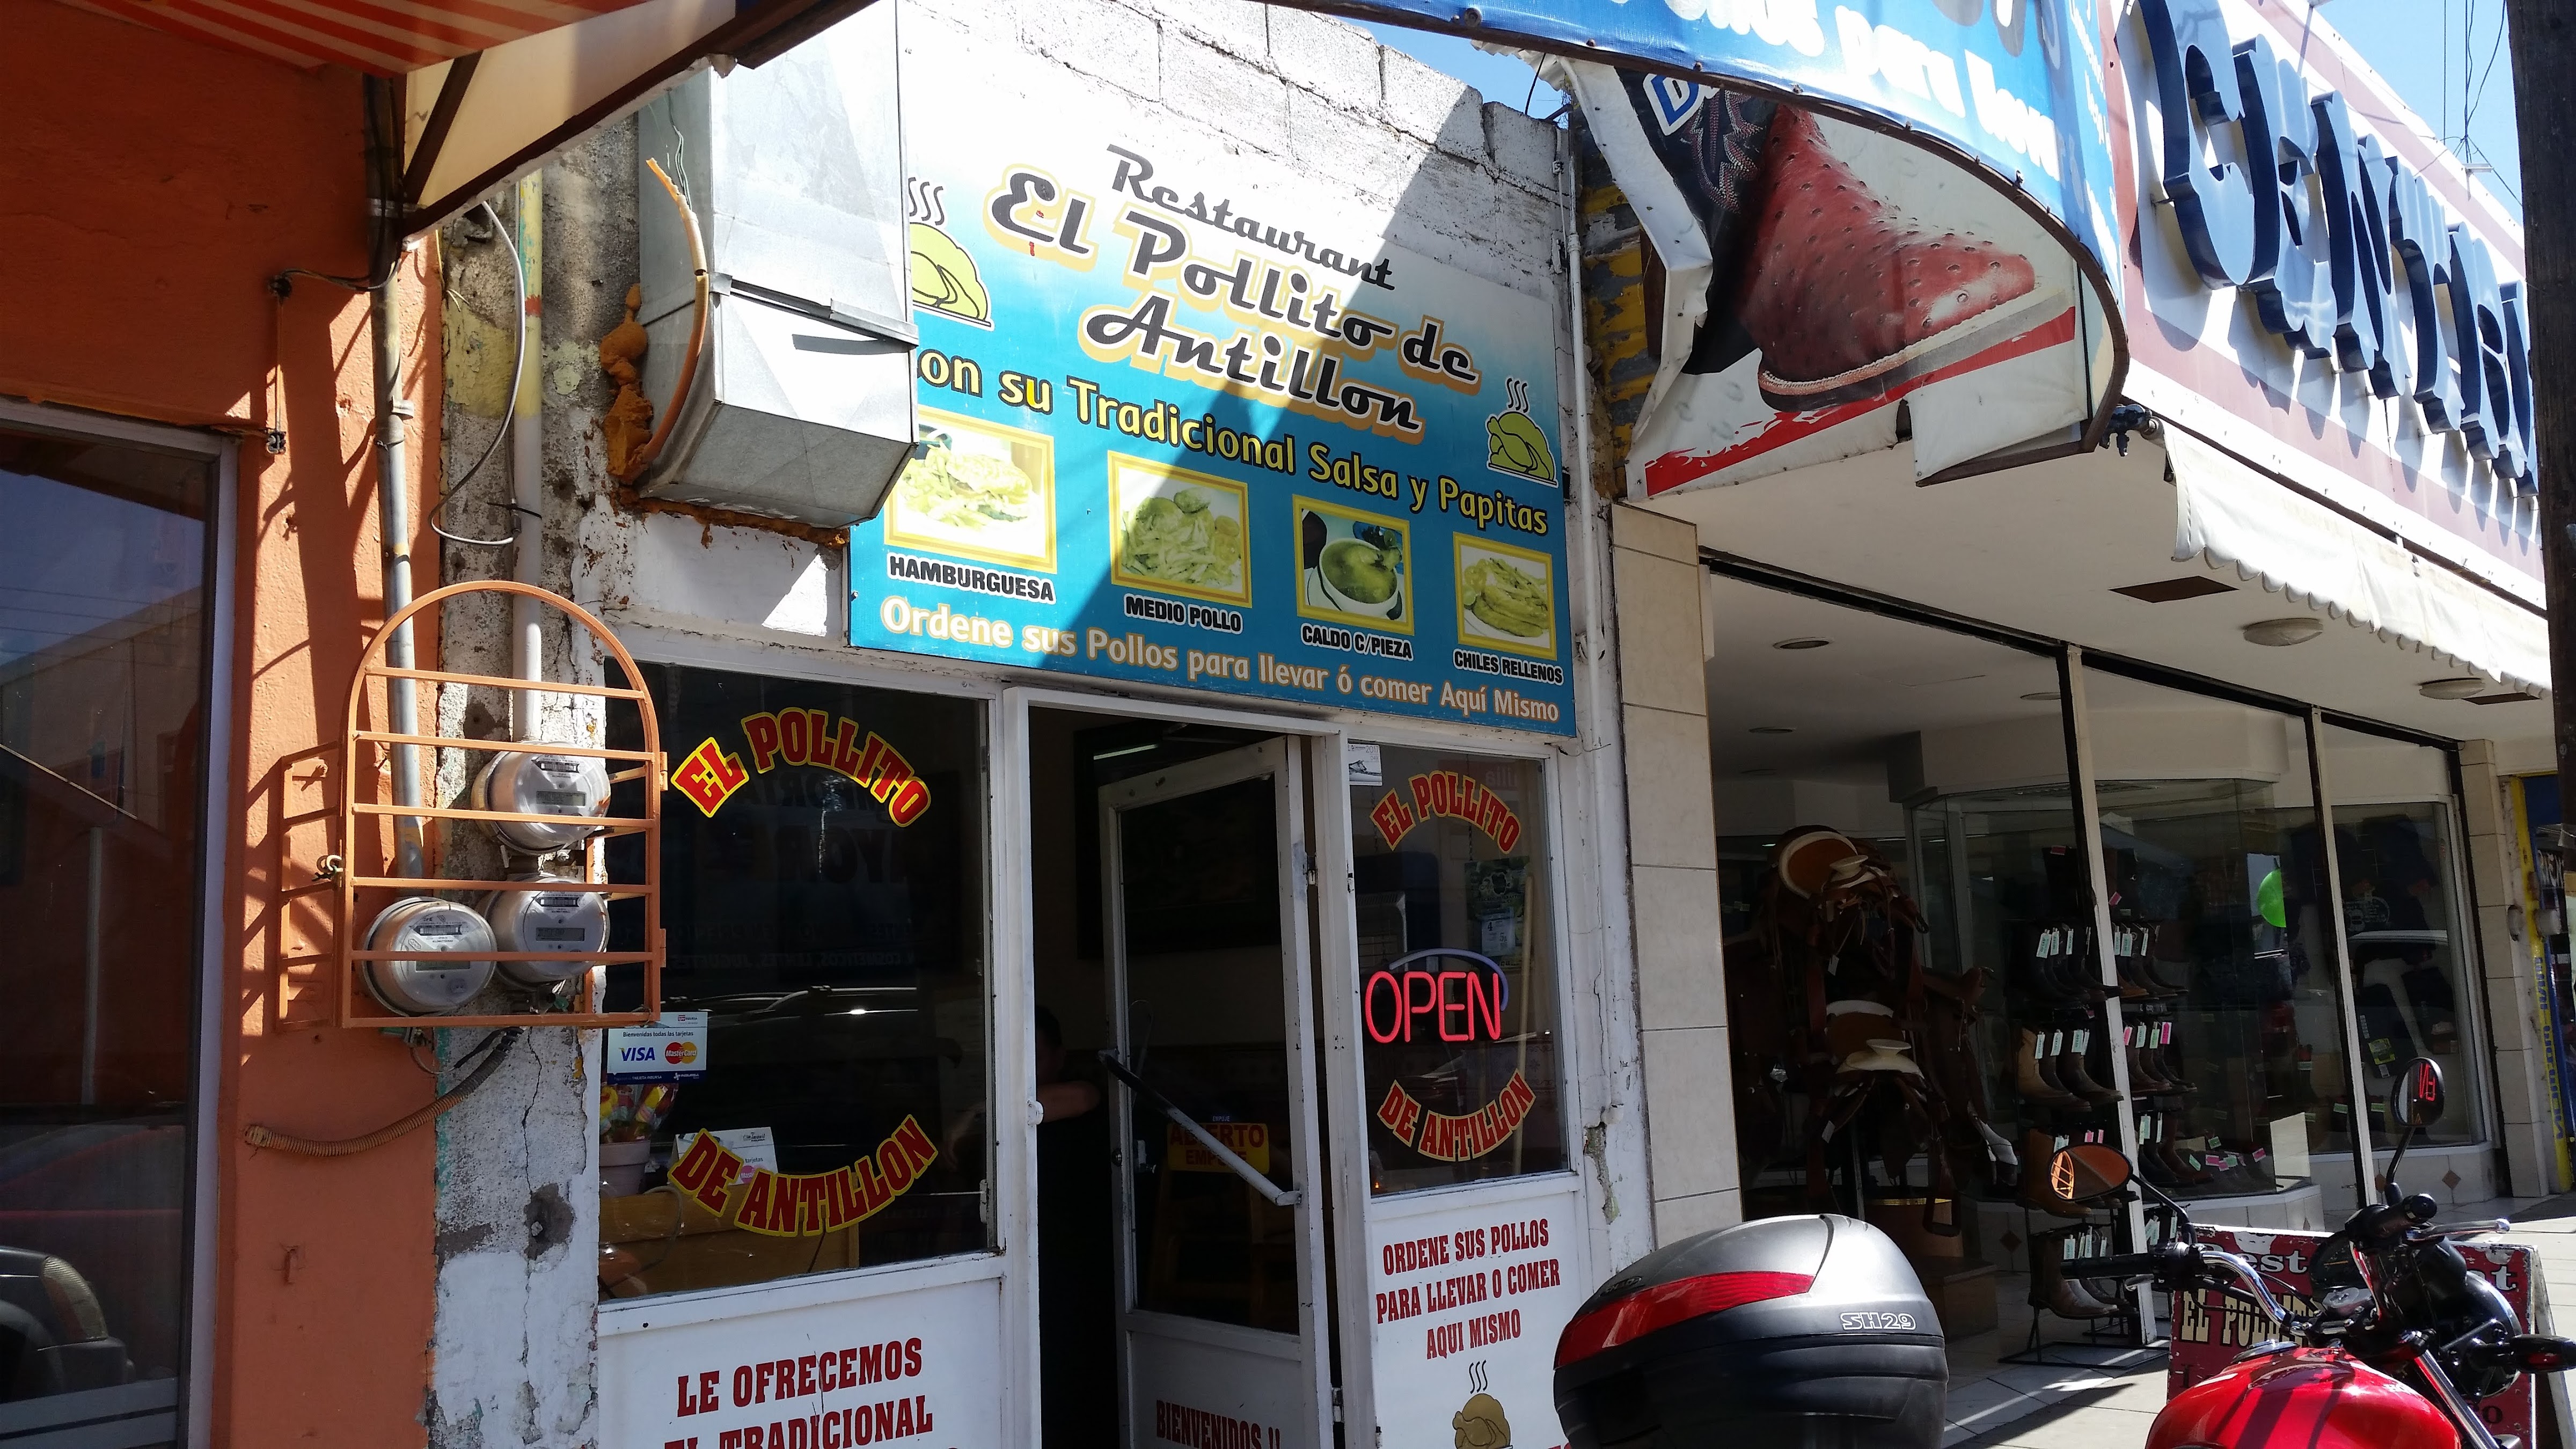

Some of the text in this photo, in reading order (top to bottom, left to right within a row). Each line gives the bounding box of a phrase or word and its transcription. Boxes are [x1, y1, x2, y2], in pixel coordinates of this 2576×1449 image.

[1107, 144, 1395, 291] Restaurant
[990, 171, 1477, 384] El Pollito de
[1085, 294, 1422, 435] Antillon
[918, 350, 1548, 535] on su Tradicional Salsa y Papitas
[889, 554, 1055, 603] HAMBURGUESA
[1126, 596, 1242, 634] MEDIO POLLO
[882, 597, 1559, 722] Ordene sus Pollos para llevar ó comer Aquí Mismo
[1301, 626, 1413, 661] CALDO C/PIEZA
[1454, 650, 1563, 684] CHILES RELLENOS
[670, 737, 749, 818] EL
[741, 707, 931, 827] POLLITO
[1370, 770, 1522, 854] EL POLLITO
[1365, 970, 1501, 1043] OPEN
[619, 1047, 655, 1061] VISA
[1377, 1068, 1536, 1162] DE ANTILLON
[668, 1114, 938, 1238] DE ANTILLON
[1382, 1218, 1548, 1276] ORDENE SUS POLLOS
[1376, 1290, 1421, 1324] PARA
[1428, 1273, 1487, 1314] LLEVAR
[1492, 1271, 1502, 1299] O
[1507, 1258, 1561, 1294] COMER
[1840, 1312, 1916, 1330] SH29
[1427, 1309, 1521, 1360] AQUI MISMO
[677, 1337, 923, 1418] LE OFRECEMOS
